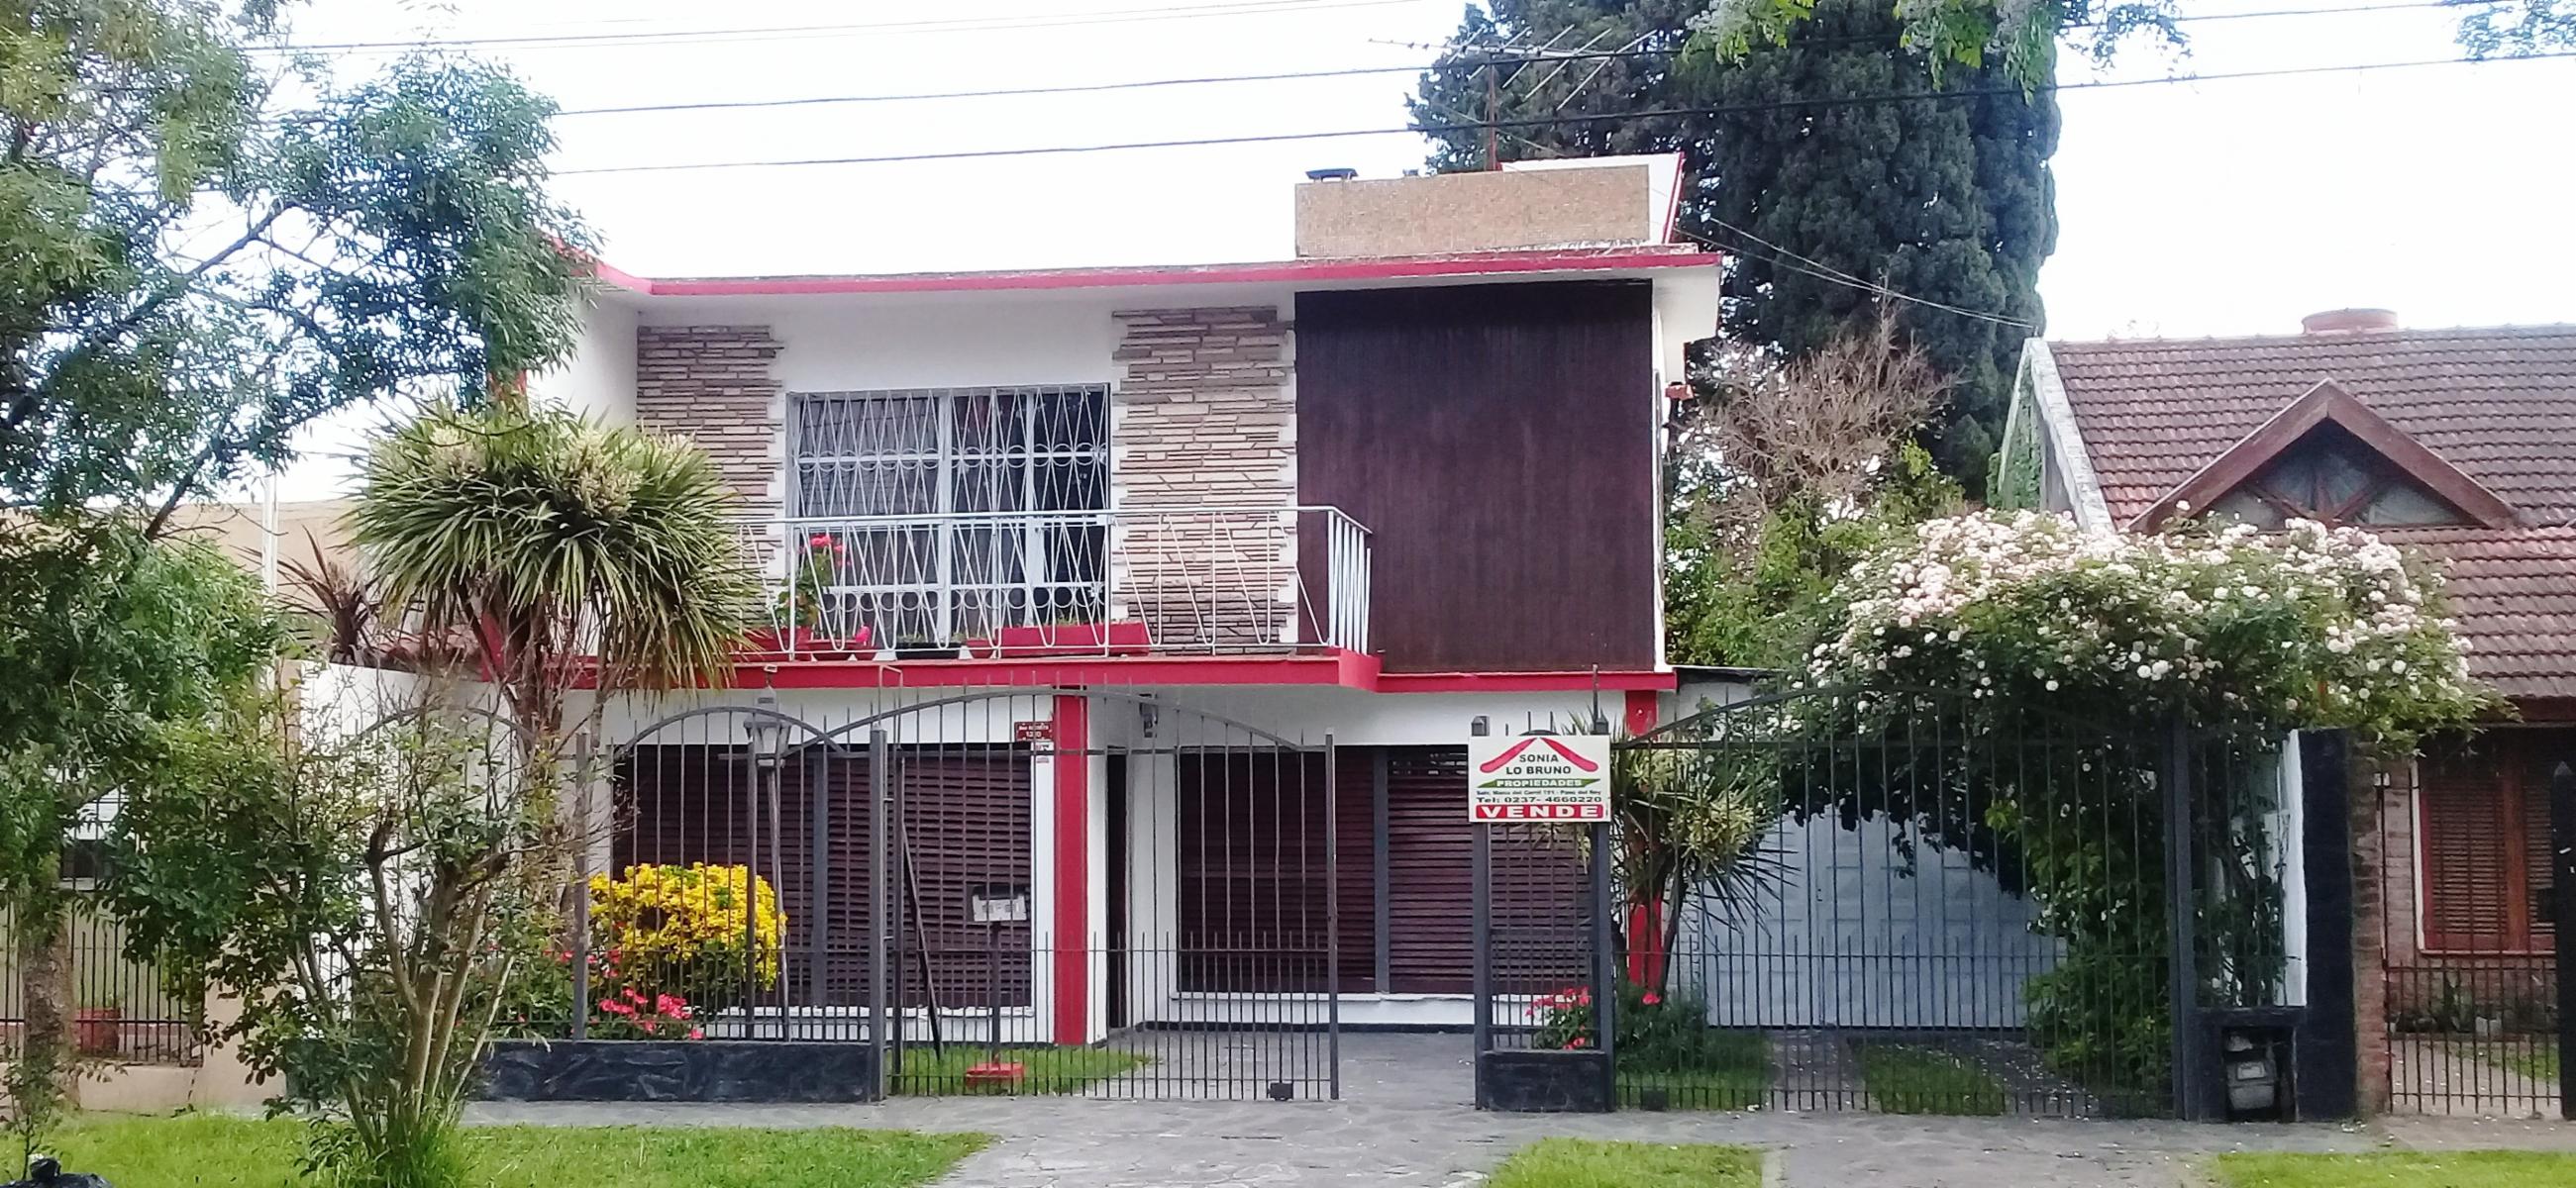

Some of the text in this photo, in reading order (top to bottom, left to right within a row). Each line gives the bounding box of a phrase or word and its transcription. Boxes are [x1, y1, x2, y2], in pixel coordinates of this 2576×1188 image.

[1519, 753, 1559, 762] SONIA
[1506, 765, 1571, 775] LO BRUNO
[1481, 806, 1598, 818] VENDE
